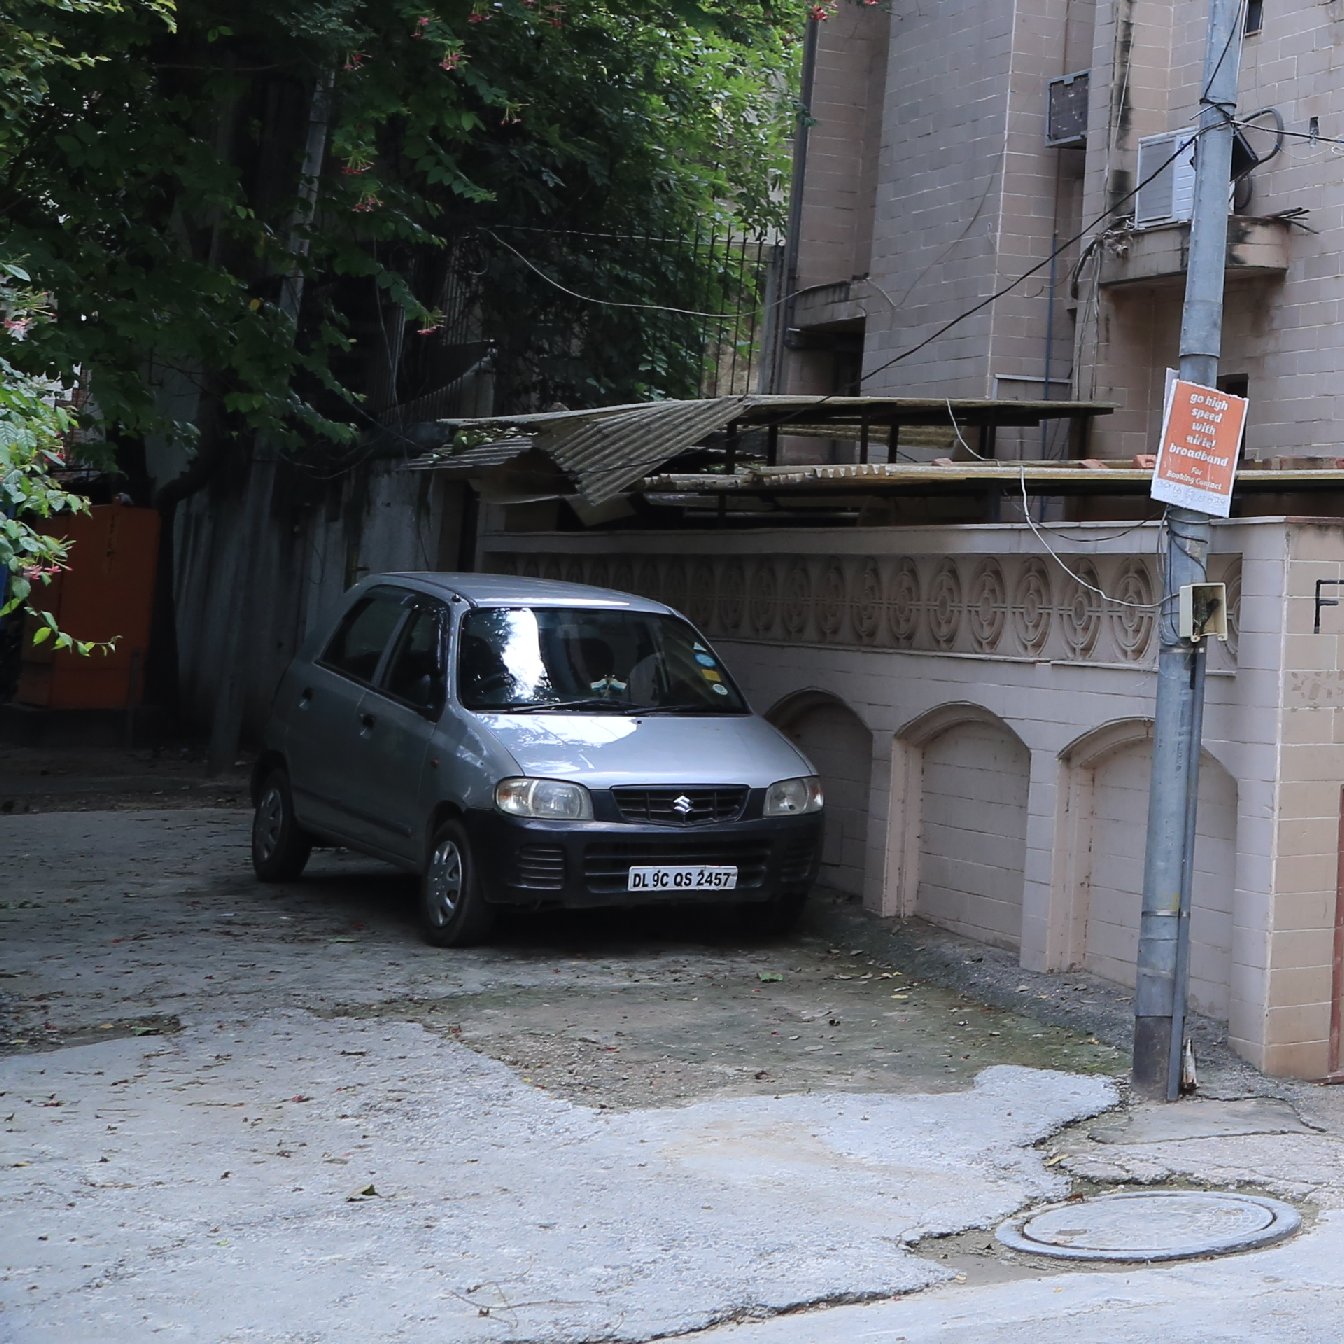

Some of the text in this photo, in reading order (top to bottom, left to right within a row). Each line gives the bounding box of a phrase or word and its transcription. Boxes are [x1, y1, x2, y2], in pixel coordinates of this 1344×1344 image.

[1190, 394, 1228, 411] go high
[1192, 408, 1222, 423] speed
[1192, 422, 1216, 434] with
[1169, 443, 1228, 466] broadband
[1166, 470, 1195, 484] Booking
[1191, 466, 1203, 476] For
[633, 870, 731, 887] DL 9C QS 2457
